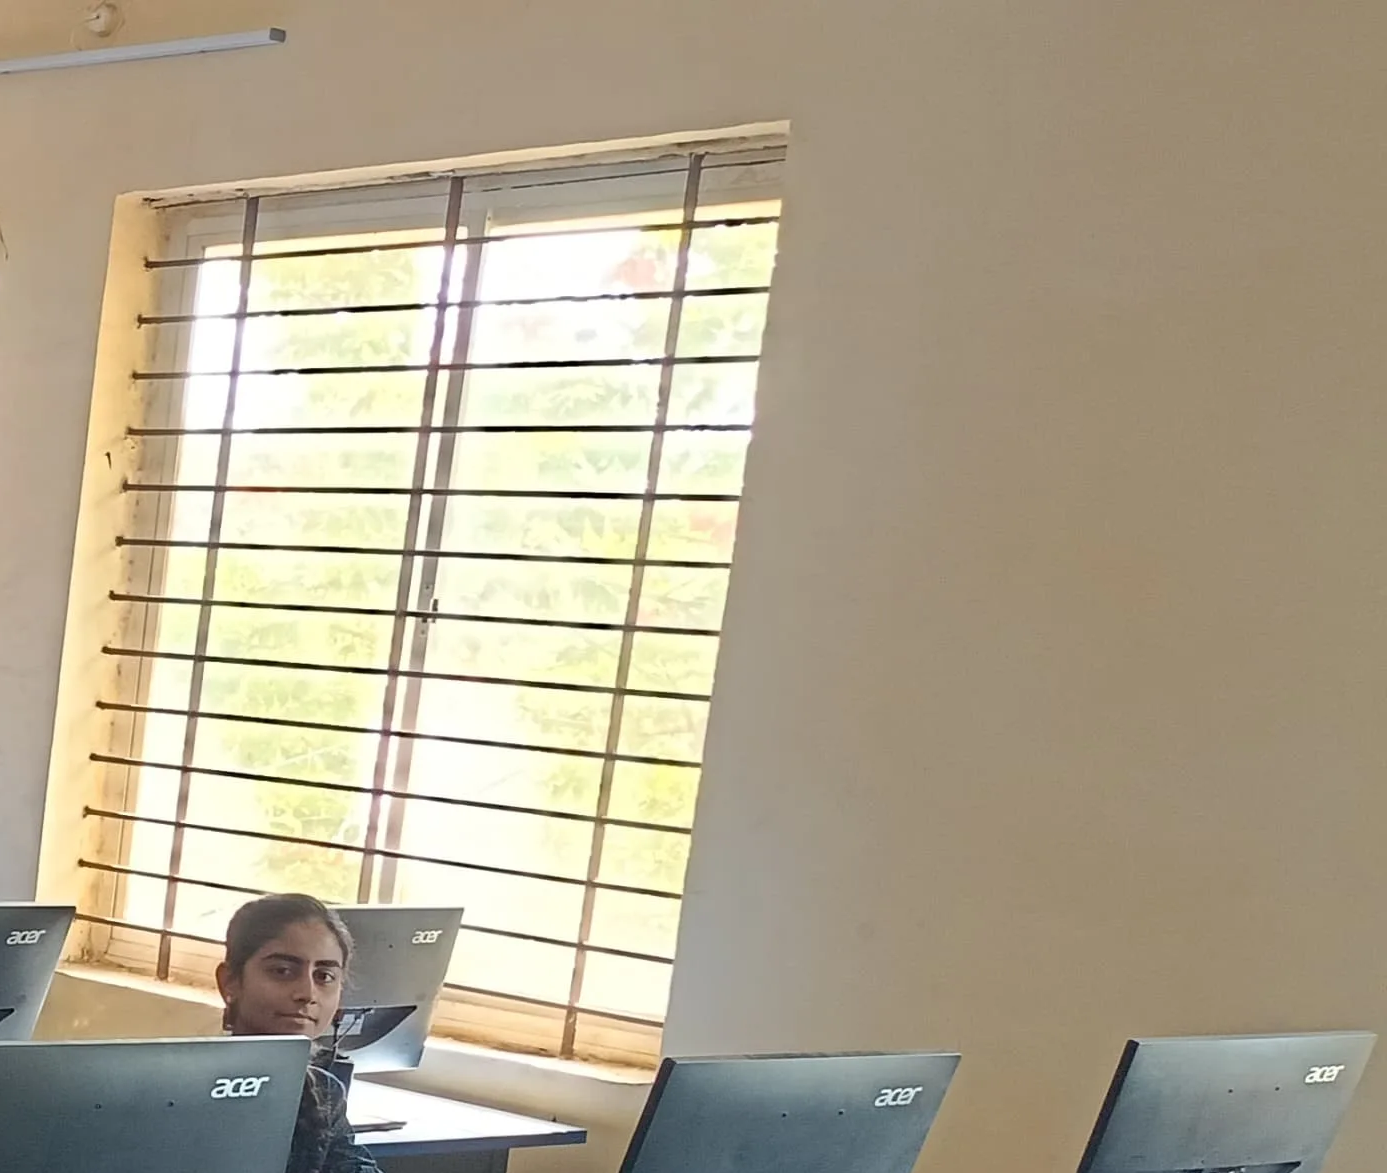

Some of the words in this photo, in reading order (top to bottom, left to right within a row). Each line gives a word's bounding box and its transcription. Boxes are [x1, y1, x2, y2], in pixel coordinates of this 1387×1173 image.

[7, 930, 46, 944] acer
[412, 931, 442, 943] acer
[1306, 1066, 1344, 1082] acer
[211, 1077, 269, 1098] acer
[875, 1087, 922, 1106] acer
